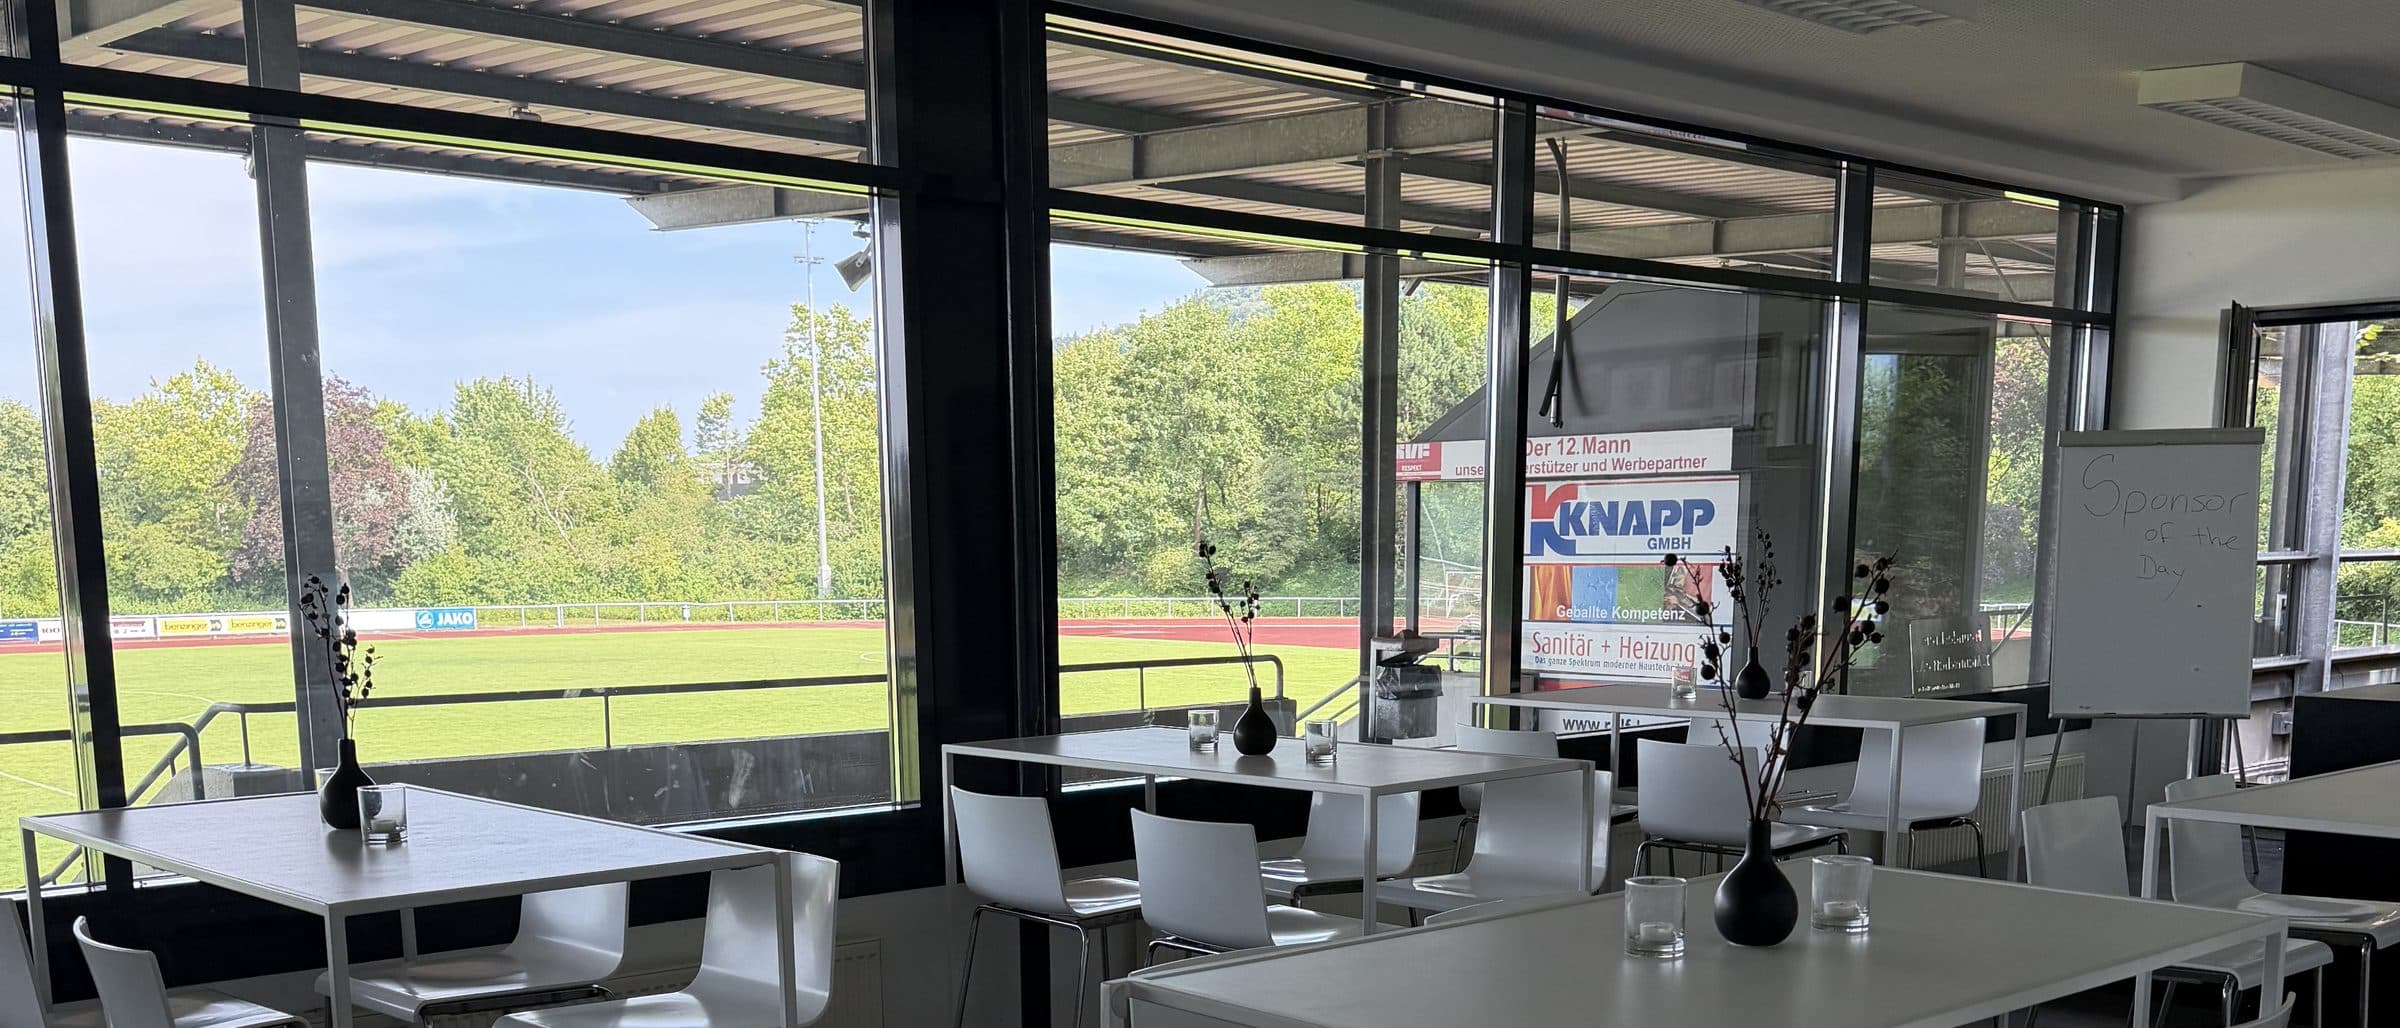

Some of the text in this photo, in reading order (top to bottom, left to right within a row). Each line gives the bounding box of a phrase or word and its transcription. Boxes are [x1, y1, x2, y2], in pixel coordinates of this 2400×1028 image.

[1526, 439, 1551, 456] Der
[1583, 436, 1631, 455] Mann
[1455, 465, 1485, 476] unse
[1582, 459, 1607, 472] und
[1612, 456, 1708, 474] Werbepartner
[2082, 453, 2249, 529] Sponsor
[1559, 498, 1716, 537] KNAPP
[1647, 537, 1691, 550] GMBH
[2144, 521, 2241, 551] of the
[2135, 554, 2186, 601] Day
[436, 611, 474, 626] JAKO
[1556, 604, 1686, 623] Geballte Kompetenz
[1532, 631, 1593, 657] Sanitär
[1619, 635, 1696, 667] Heizung
[1534, 655, 1546, 664] Das
[1568, 657, 1601, 668] Spektrum
[1603, 660, 1637, 670] moderner
